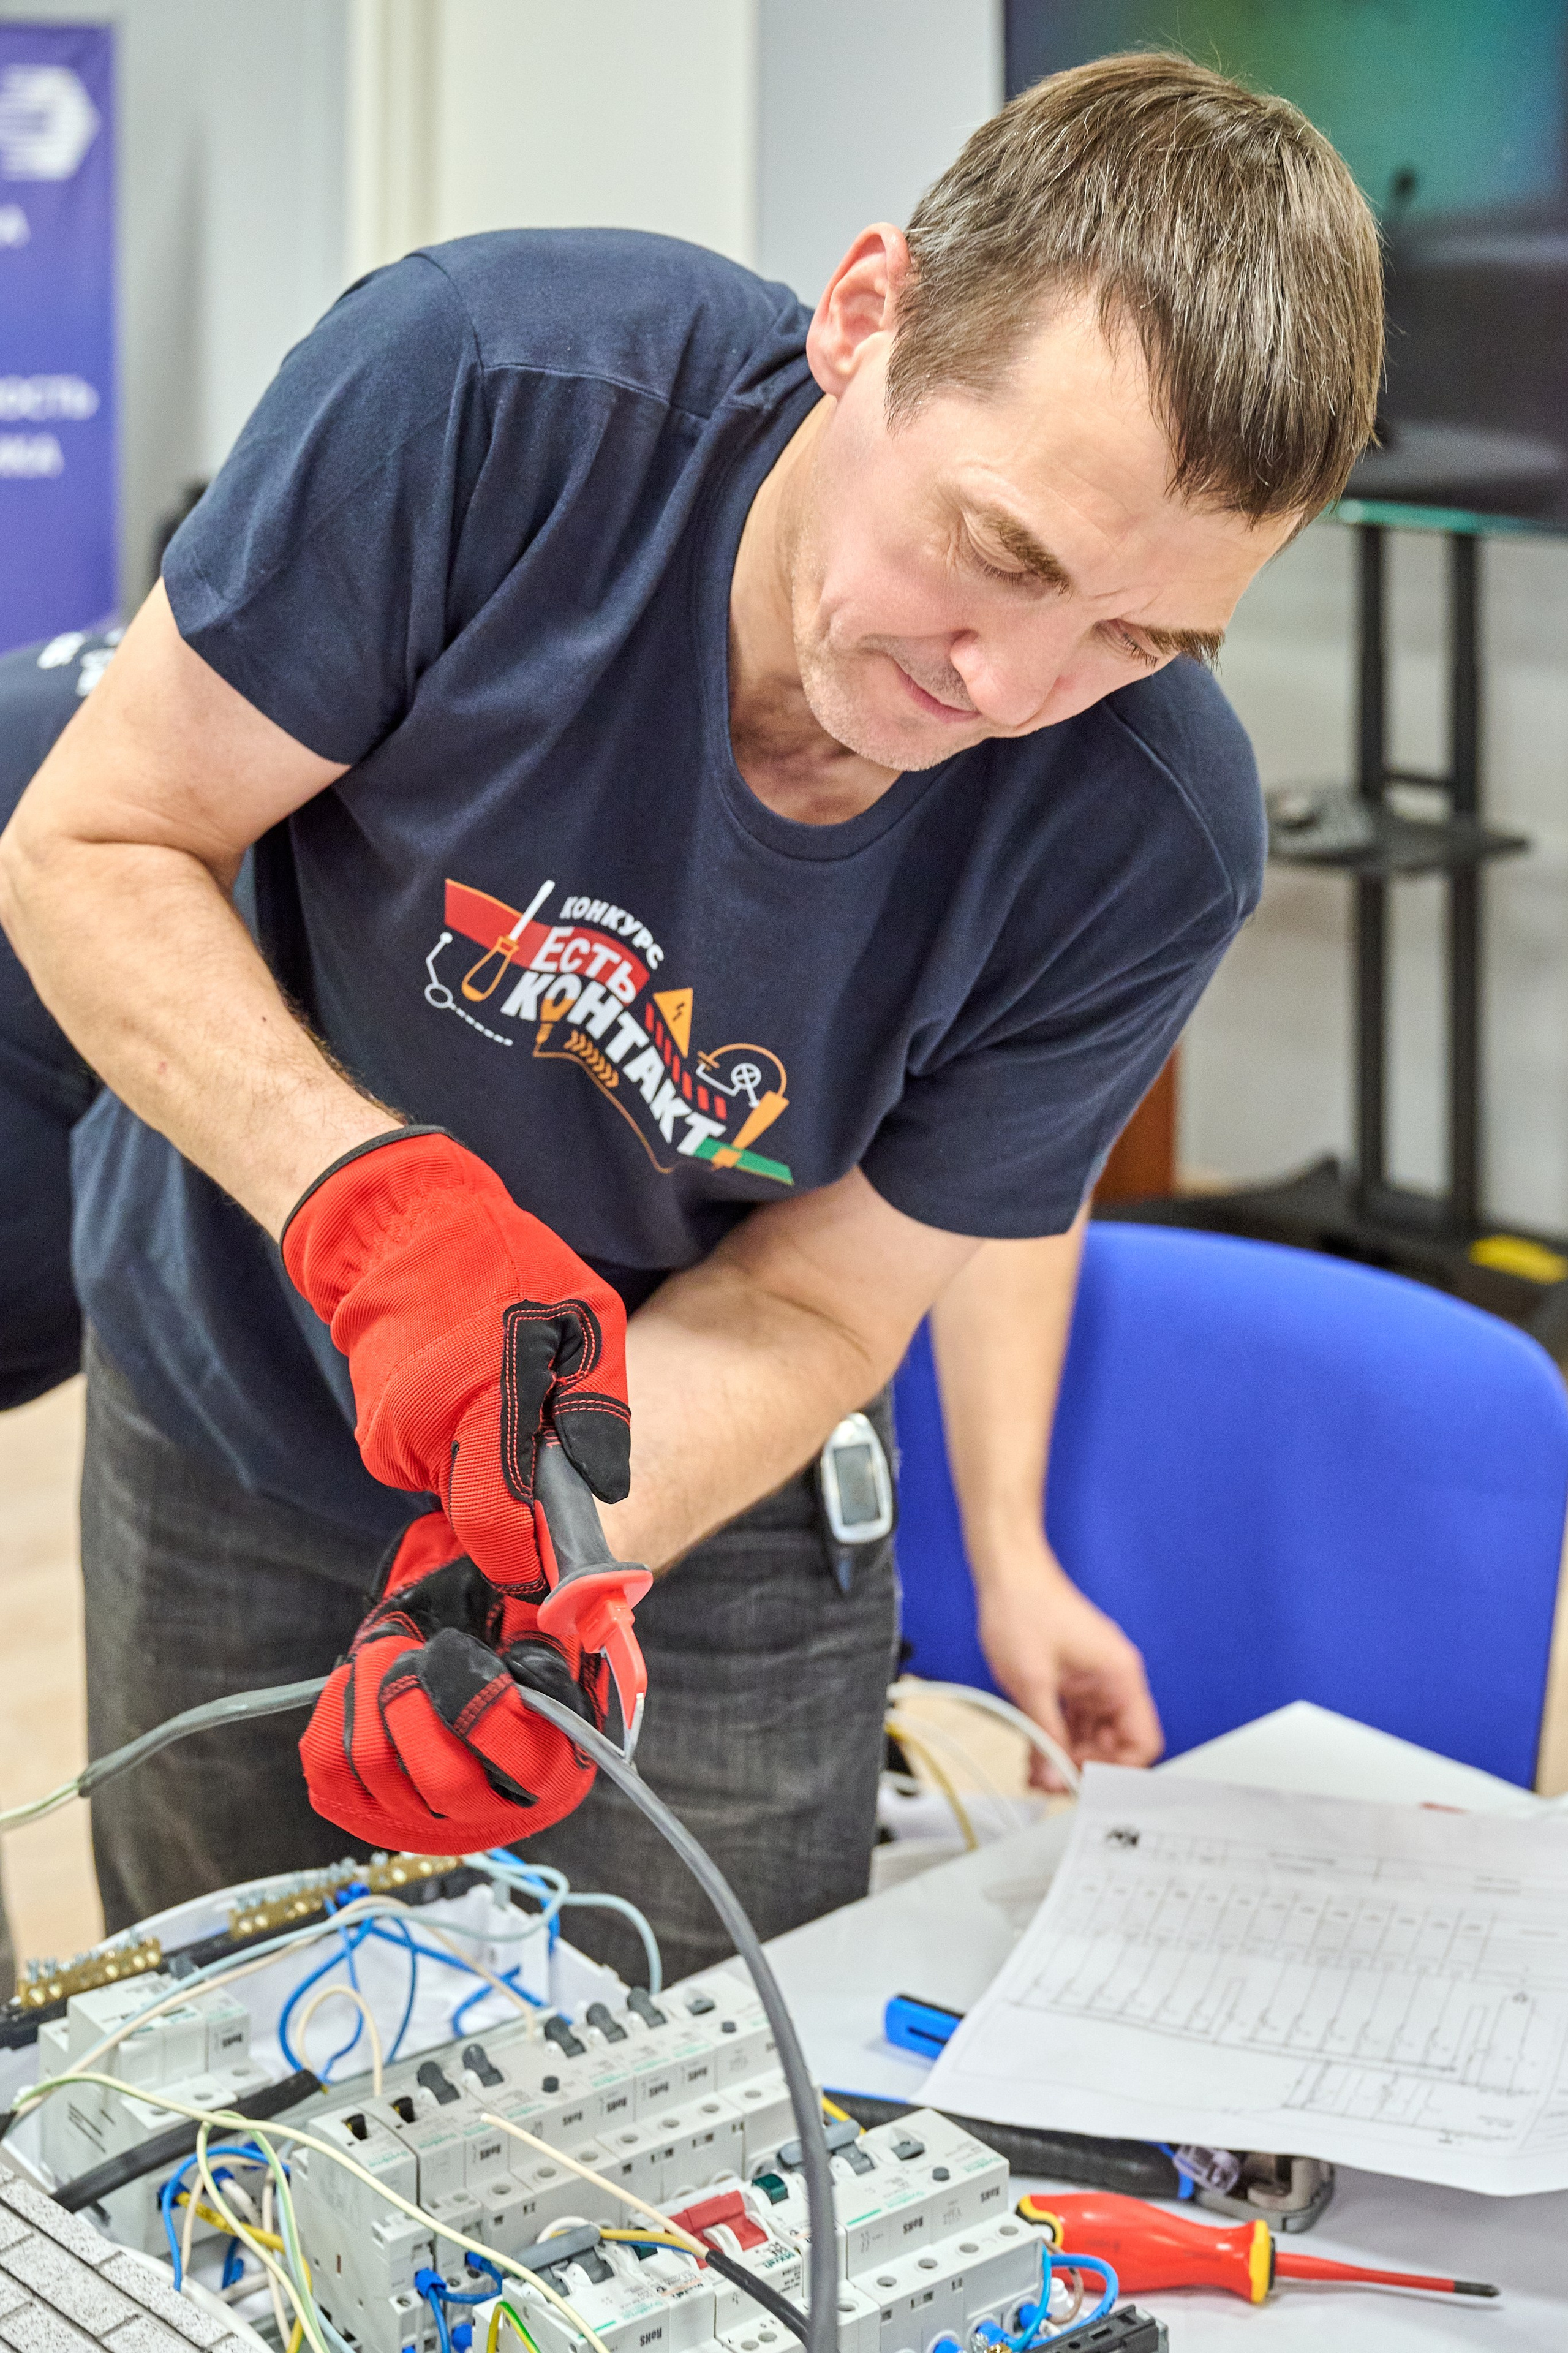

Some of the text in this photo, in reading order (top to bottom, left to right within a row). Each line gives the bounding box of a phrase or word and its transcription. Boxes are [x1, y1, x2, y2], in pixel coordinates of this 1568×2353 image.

[530, 926, 636, 1004] ЕСТЬ
[559, 897, 665, 970] КОНКУРС
[500, 971, 726, 1155] КОНТАКТ
[640, 2327, 662, 2347] RoHS
